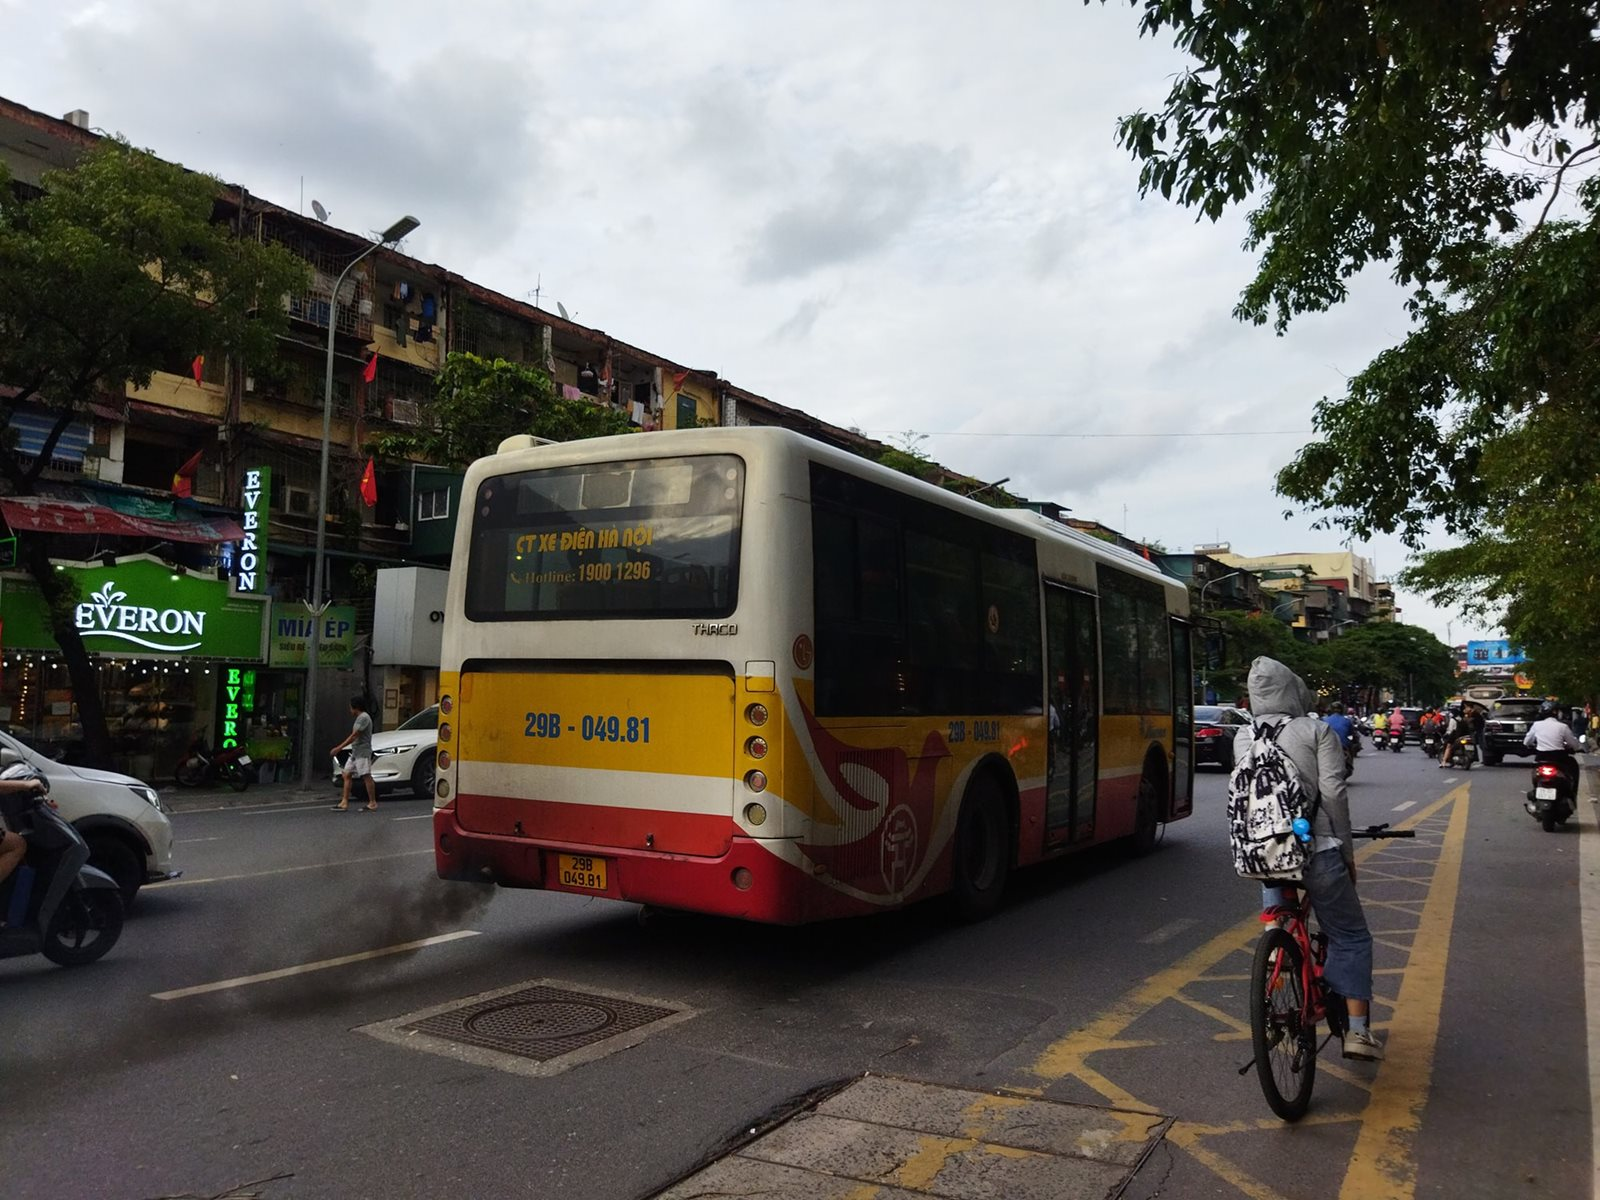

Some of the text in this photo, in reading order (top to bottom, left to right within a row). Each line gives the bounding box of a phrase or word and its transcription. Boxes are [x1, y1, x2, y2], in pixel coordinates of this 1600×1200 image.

[238, 470, 261, 591] EVERON
[516, 535, 537, 553] CT
[538, 532, 558, 552] XE
[525, 561, 650, 584] Hotline: 1900 1296
[75, 603, 206, 635] EVERON
[691, 623, 738, 636] THACO
[524, 712, 561, 739] 29B
[581, 715, 650, 743] 049.81
[948, 720, 965, 742] 29B
[564, 857, 601, 888] 29B 049.81
